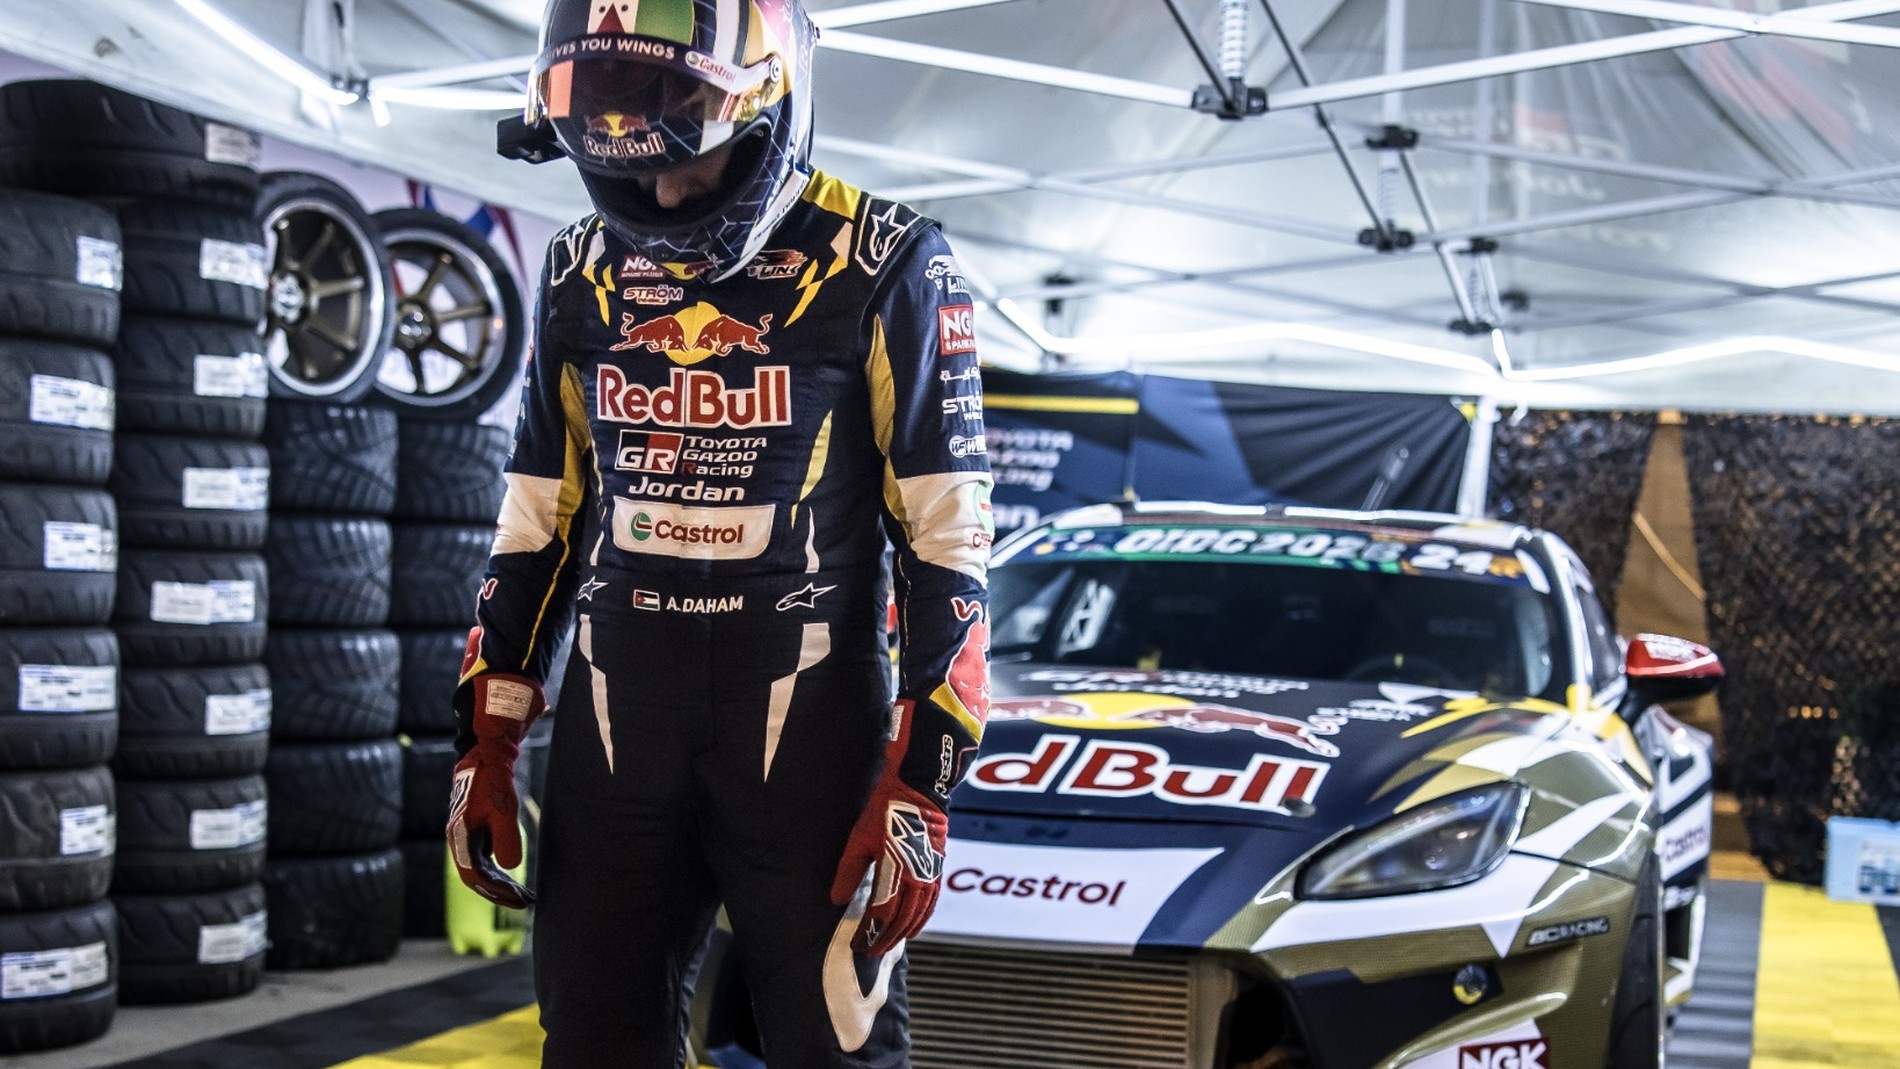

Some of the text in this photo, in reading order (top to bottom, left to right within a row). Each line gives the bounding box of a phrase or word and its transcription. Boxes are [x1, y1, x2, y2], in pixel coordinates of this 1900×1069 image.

[581, 38, 611, 51] YOU
[617, 39, 675, 60] WINGS
[623, 256, 658, 271] NG
[624, 285, 683, 300] STRÖM
[942, 310, 973, 339] NG
[942, 391, 983, 414] STRÖ
[684, 435, 768, 449] TOYOTA
[617, 446, 676, 472] GR
[682, 449, 758, 463] GAZOO
[681, 463, 754, 478] Racing
[628, 476, 746, 502] Jordan
[655, 520, 744, 544] Castrol
[1410, 542, 1493, 575] 24
[1057, 739, 1331, 816] Bull
[946, 867, 1127, 907] Castrol
[1462, 1041, 1548, 1069] NGK
